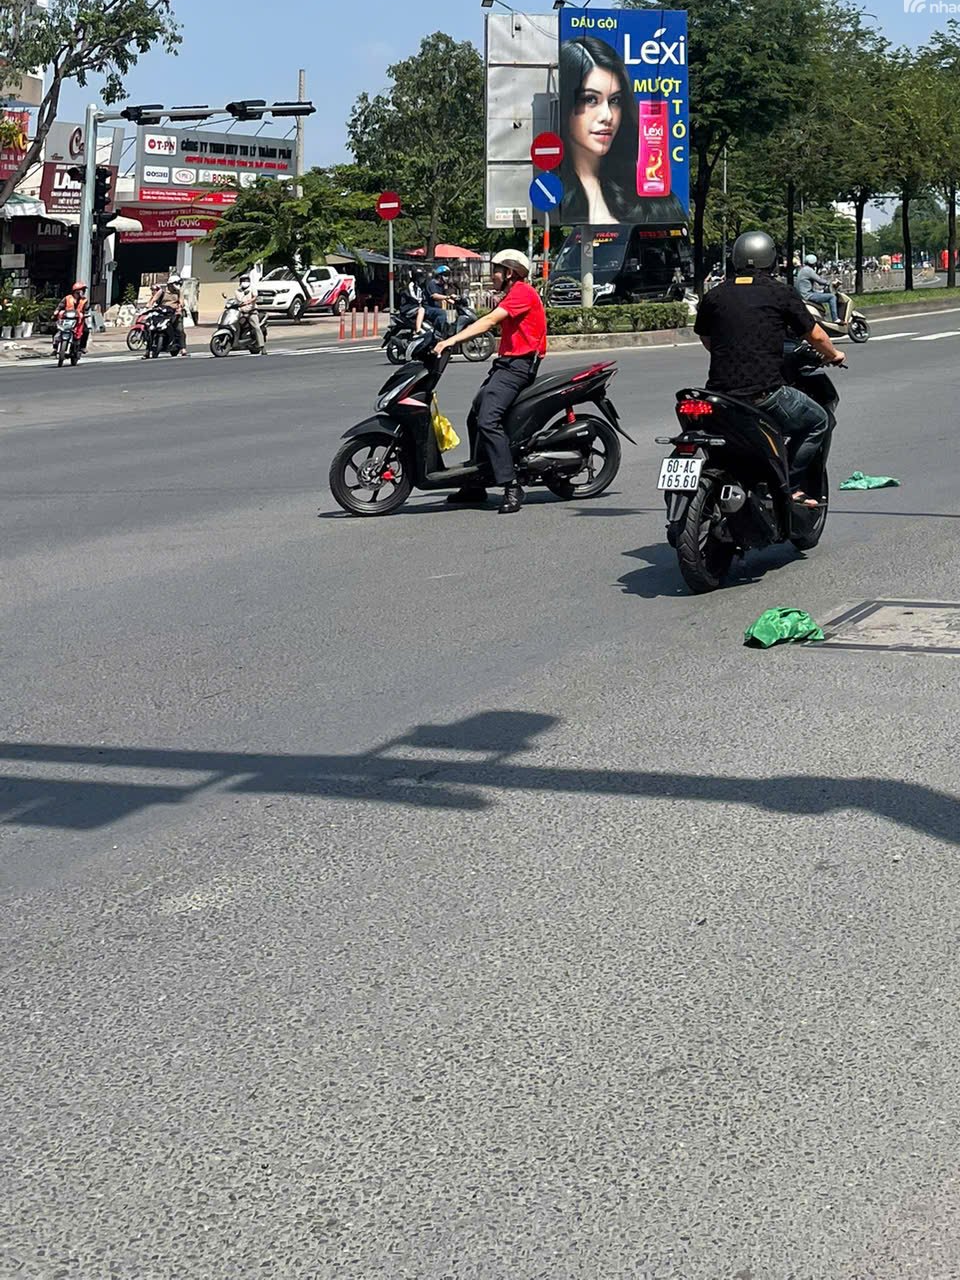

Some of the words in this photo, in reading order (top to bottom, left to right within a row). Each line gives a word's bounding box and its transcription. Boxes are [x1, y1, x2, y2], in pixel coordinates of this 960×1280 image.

[597, 16, 617, 31] GỘI
[624, 27, 686, 65] Léxi
[633, 76, 682, 97] MƯỢT
[661, 474, 697, 488] 165.60
